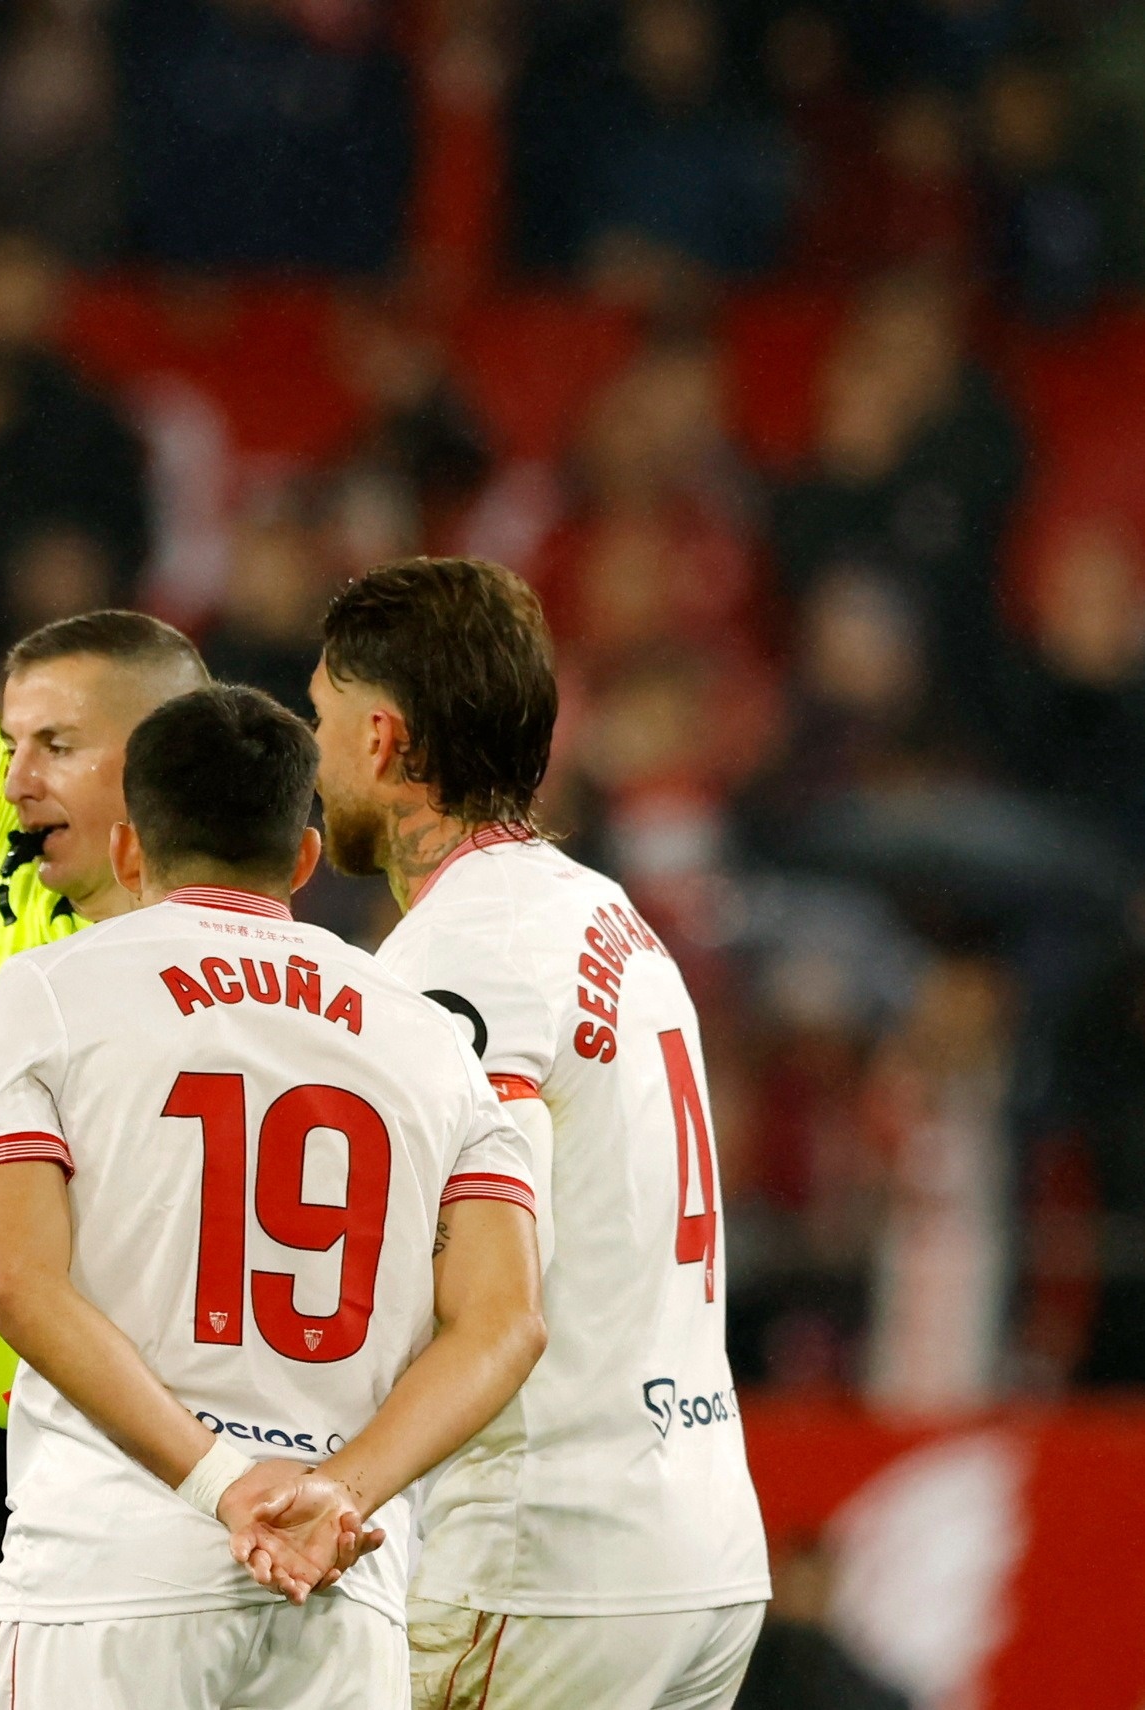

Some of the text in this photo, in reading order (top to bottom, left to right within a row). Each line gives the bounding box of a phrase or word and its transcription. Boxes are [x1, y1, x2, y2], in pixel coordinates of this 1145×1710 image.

[159, 954, 364, 1036] ACUÑA
[160, 1072, 392, 1363] 19
[657, 1028, 718, 1304] 4
